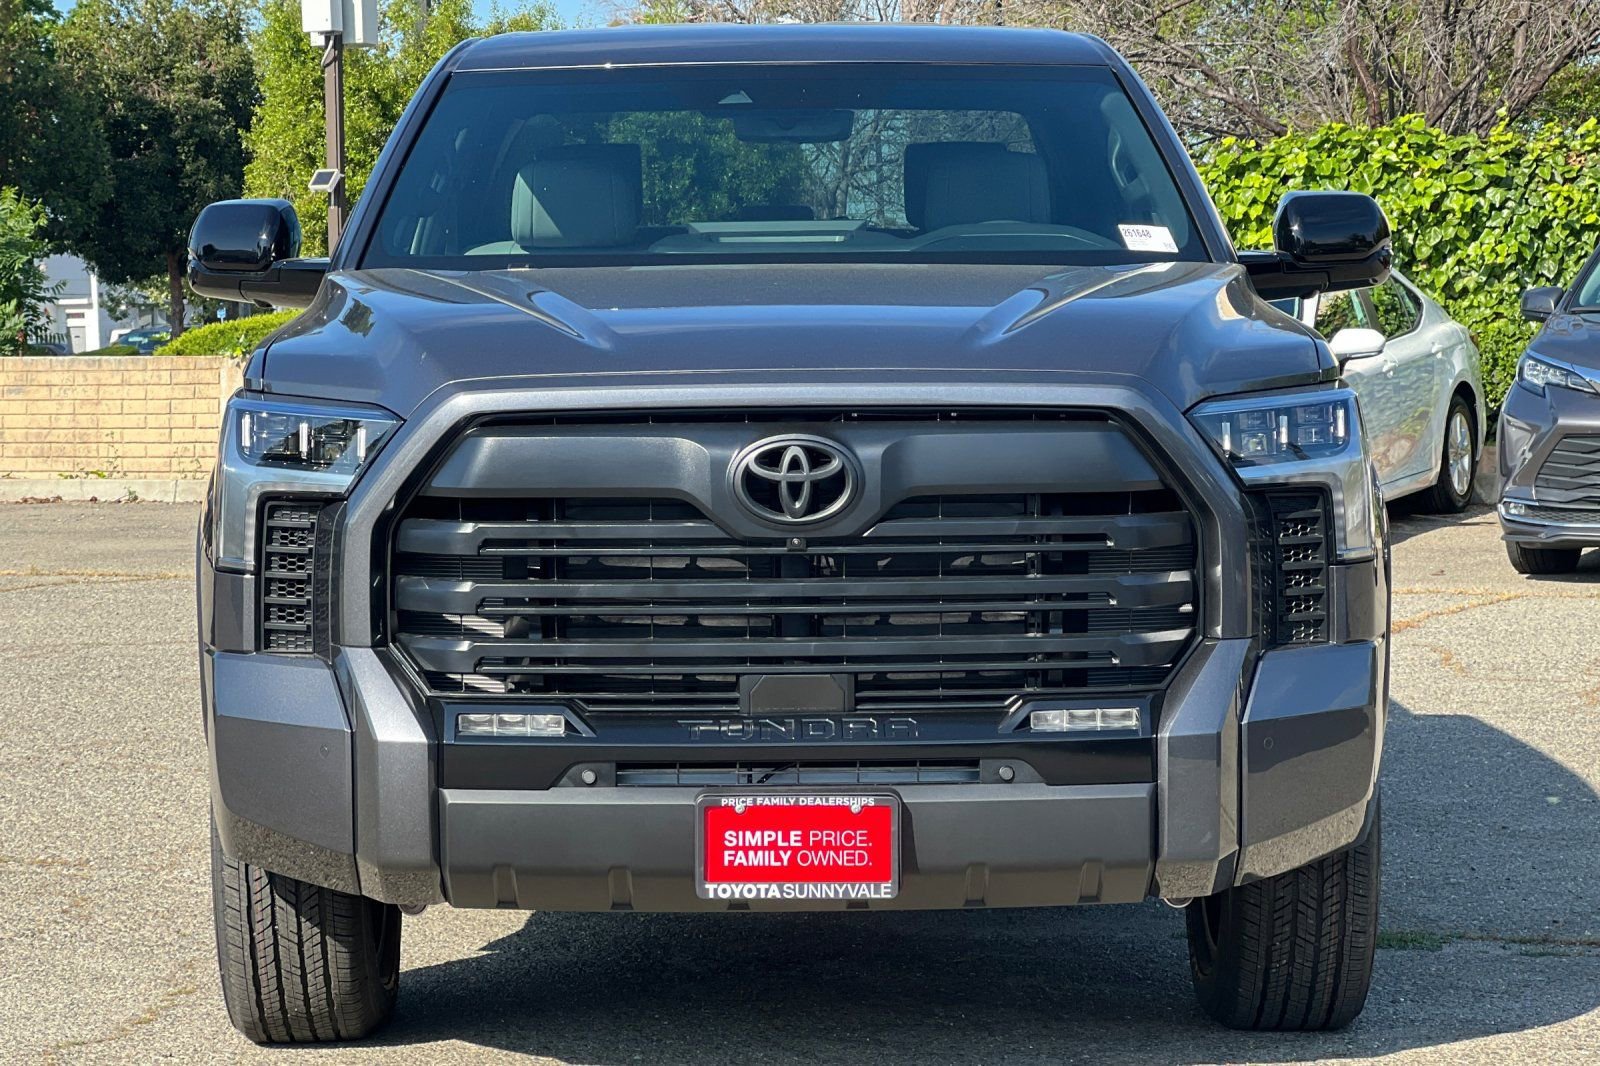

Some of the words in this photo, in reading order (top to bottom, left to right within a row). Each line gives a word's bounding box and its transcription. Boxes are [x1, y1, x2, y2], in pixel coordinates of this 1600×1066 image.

[677, 719, 918, 740] TUNDRA
[721, 798, 753, 806] PRICE
[756, 798, 796, 806] FAMILY
[799, 798, 874, 806] DEALERSHIPS
[724, 830, 802, 847] SIMPLE
[809, 831, 872, 846] PRICE.
[723, 850, 791, 866] FAMILY
[797, 851, 872, 866] OWNED.
[705, 884, 780, 898] TOYOTA
[783, 884, 891, 898] SUNNYVALE
